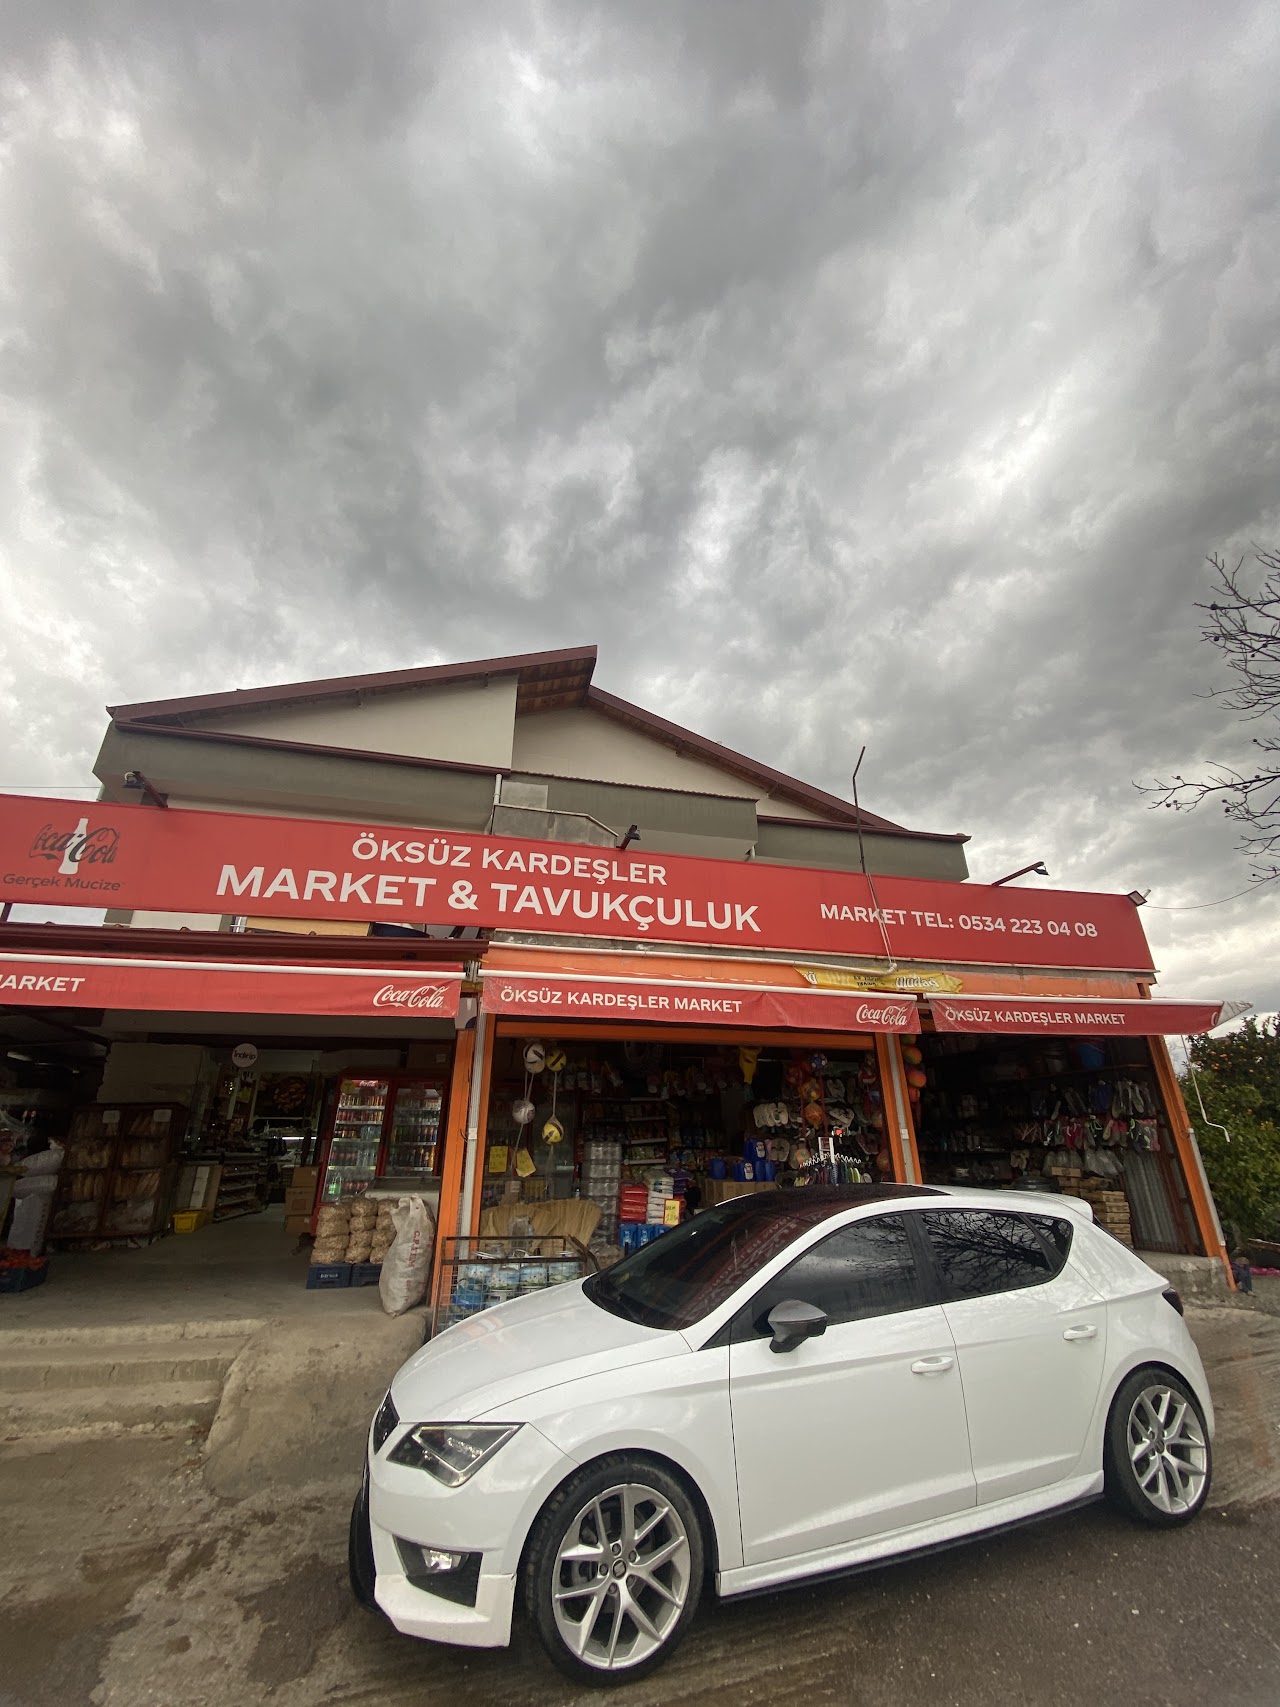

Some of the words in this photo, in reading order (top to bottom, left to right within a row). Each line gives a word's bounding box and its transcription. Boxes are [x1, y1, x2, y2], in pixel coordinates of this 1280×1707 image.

[352, 832, 472, 868] ÖKSÜZ
[482, 848, 667, 886] KARDEŞLER
[3, 873, 60, 888] Gerçek
[64, 877, 121, 891] Mucize
[216, 864, 437, 907] MARKET
[447, 880, 479, 911] &
[490, 882, 762, 932] TAVUKÇULUK
[820, 903, 907, 925] MARKET
[911, 911, 954, 929] TEL:
[959, 914, 1006, 932] 0534
[1009, 918, 1043, 935] 223
[1047, 920, 1071, 936] 04
[1074, 922, 1098, 937] 08
[0, 974, 86, 992] ARKET
[372, 984, 447, 1009] Coca-Cola
[500, 985, 562, 1005] ÖKSÜZ
[567, 992, 670, 1011] KARDEŞLER
[674, 998, 742, 1013] MARKET
[856, 1004, 908, 1026] Coca-Cola
[945, 1006, 992, 1022] ÖKSÜZ
[995, 1010, 1072, 1026] KARDEŞLER
[1074, 1013, 1126, 1025] MARKET
